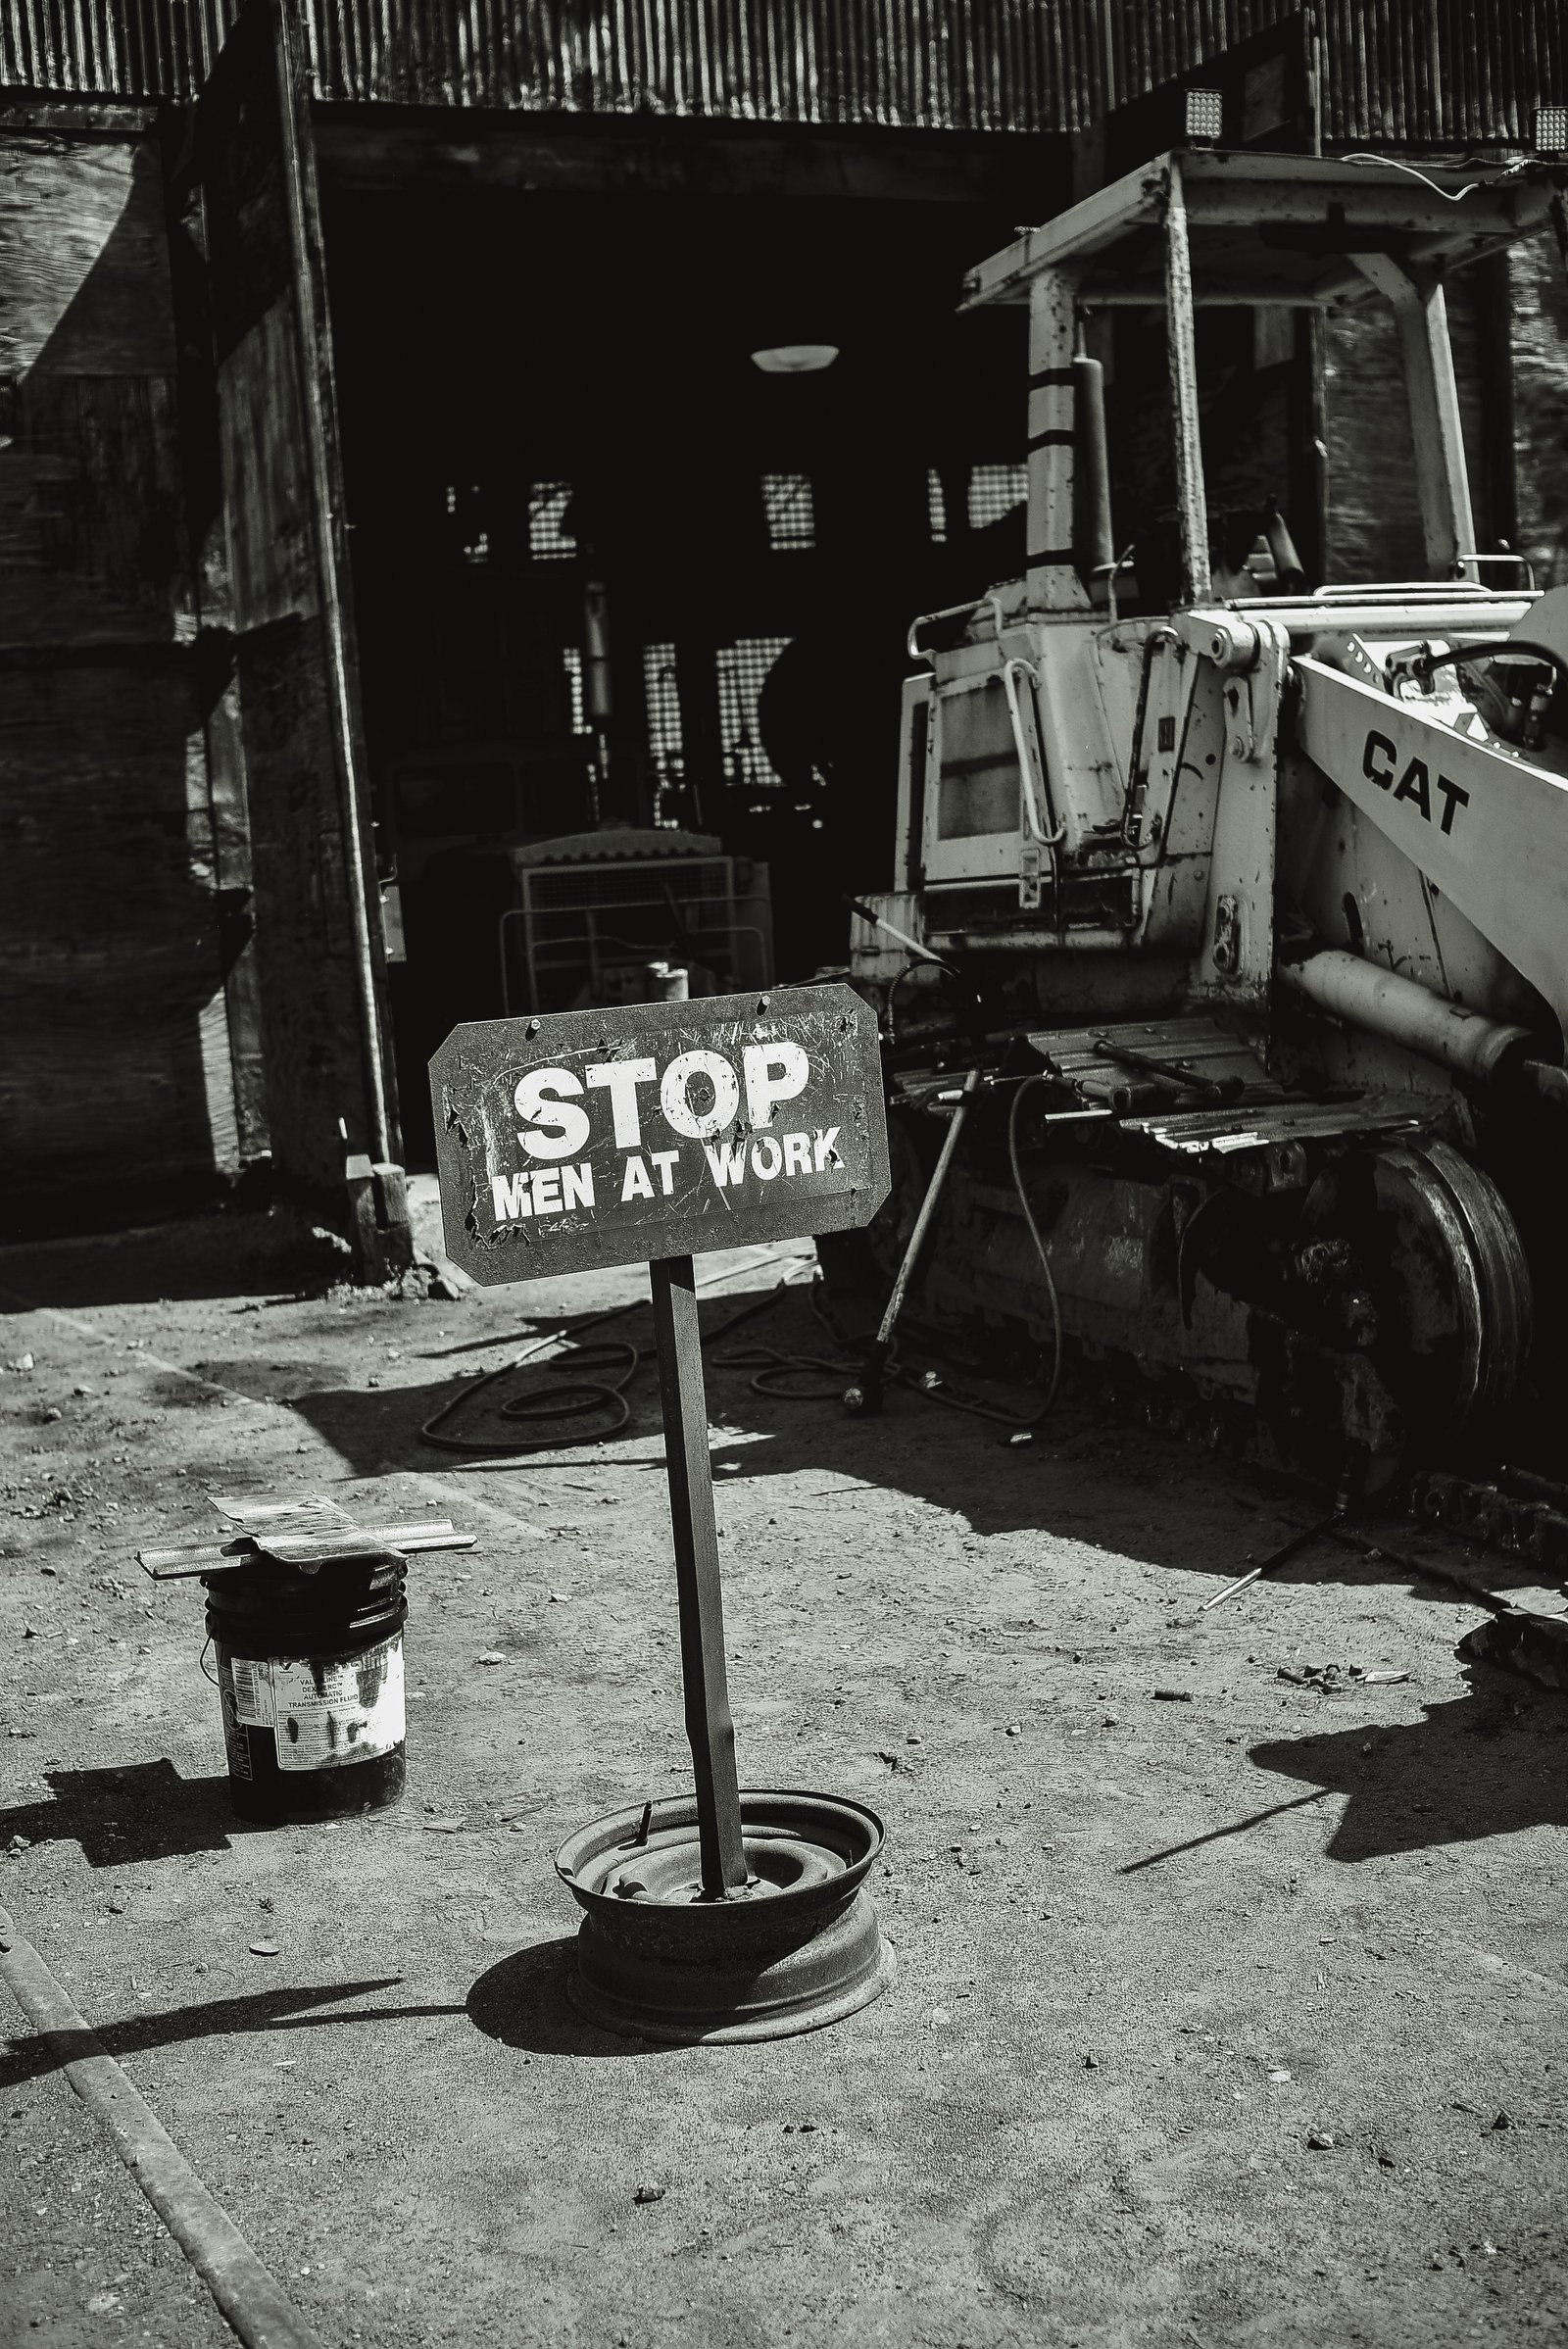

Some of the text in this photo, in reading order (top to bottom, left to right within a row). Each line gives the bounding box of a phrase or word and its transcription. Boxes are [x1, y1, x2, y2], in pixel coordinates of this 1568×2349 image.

[1362, 729, 1470, 836] CAT
[514, 1041, 809, 1160] STOP
[491, 1126, 847, 1222] MEN AT WORK
[288, 1693, 359, 1708] TRANSMISSION FLUID
[303, 1689, 343, 1700] AUTOMATIC
